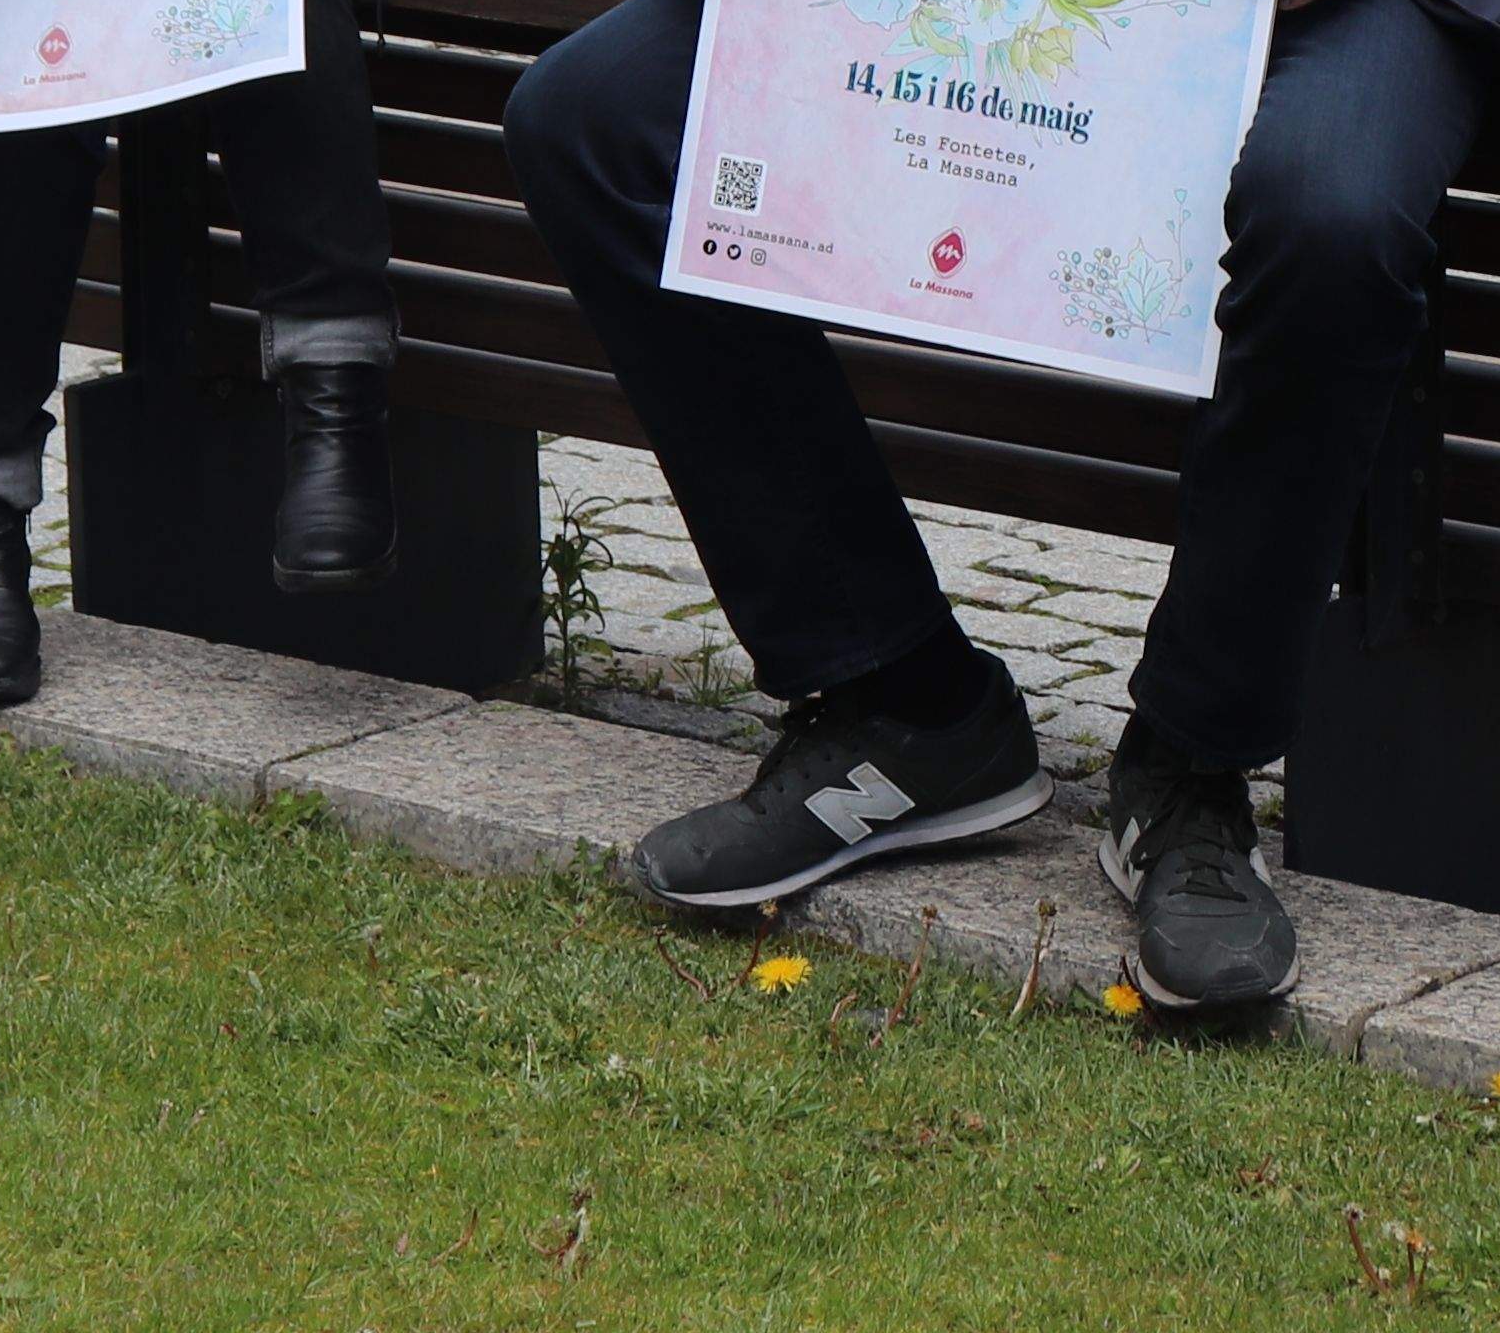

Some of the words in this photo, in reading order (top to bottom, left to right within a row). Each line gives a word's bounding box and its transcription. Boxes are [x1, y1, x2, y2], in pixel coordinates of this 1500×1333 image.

[23, 74, 36, 85] La
[39, 71, 87, 84] Massana
[844, 60, 883, 102] 14,
[891, 69, 923, 103] 15
[927, 76, 938, 106] i
[943, 79, 976, 113] 16
[981, 86, 1013, 121] de
[1018, 101, 1093, 144] maig
[893, 127, 927, 146] Les
[938, 135, 1036, 170] Fontetes,
[906, 152, 929, 170] La
[940, 160, 1018, 187] Massana
[707, 221, 834, 254] www.lamassana.ad
[909, 278, 922, 289] La
[925, 280, 974, 299] Massana
